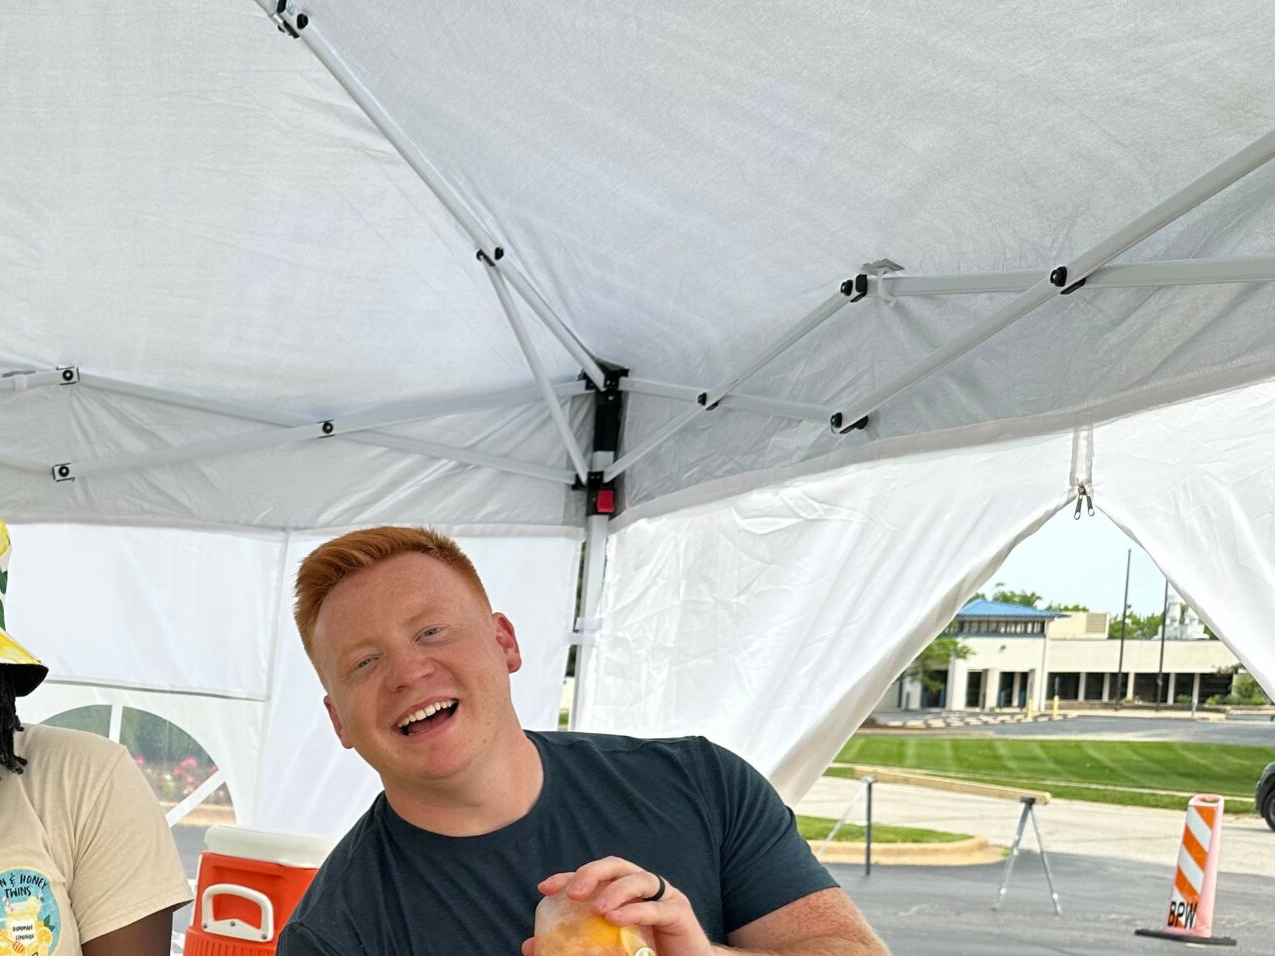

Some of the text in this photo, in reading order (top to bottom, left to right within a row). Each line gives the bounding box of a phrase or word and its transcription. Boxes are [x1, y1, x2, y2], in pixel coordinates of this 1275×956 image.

[9, 872, 16, 888] &
[20, 874, 48, 890] HONEY
[4, 886, 32, 898] TWINS
